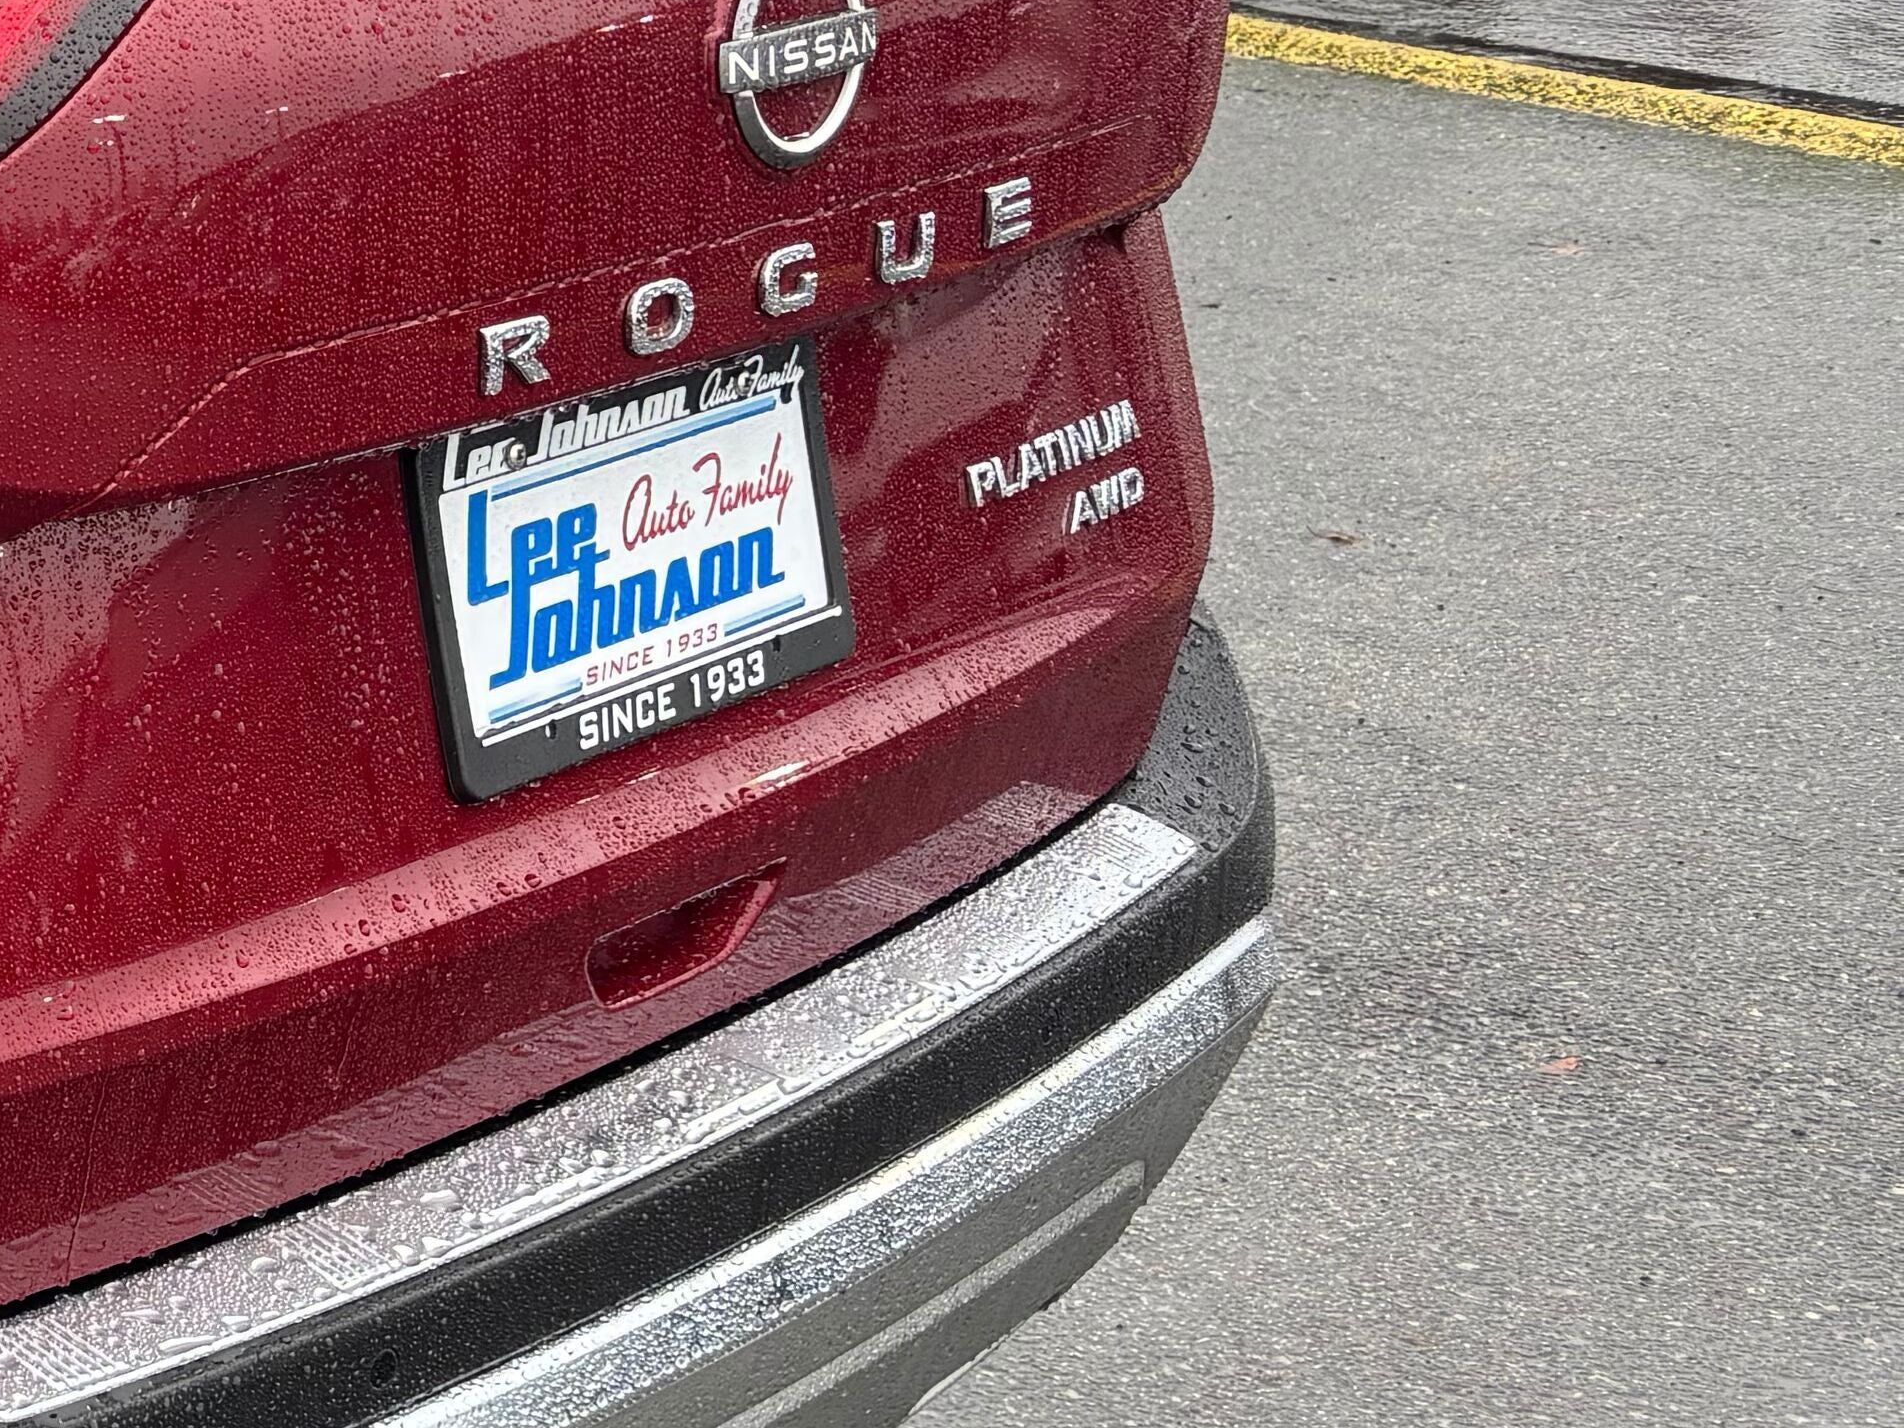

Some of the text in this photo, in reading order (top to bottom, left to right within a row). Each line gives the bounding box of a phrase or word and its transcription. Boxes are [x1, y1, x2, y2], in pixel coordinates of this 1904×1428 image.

[727, 21, 876, 85] NISSAN
[479, 176, 1033, 396] ROGUE
[526, 384, 691, 462] Johnson
[742, 344, 804, 402] Family
[965, 399, 1142, 508] PLATINUM
[467, 431, 793, 606] Lee Auto Family
[1069, 467, 1145, 535] AWD
[489, 526, 786, 691] Johnson
[585, 622, 719, 687] SINCE 1933
[578, 649, 765, 751] SINCE 1933
